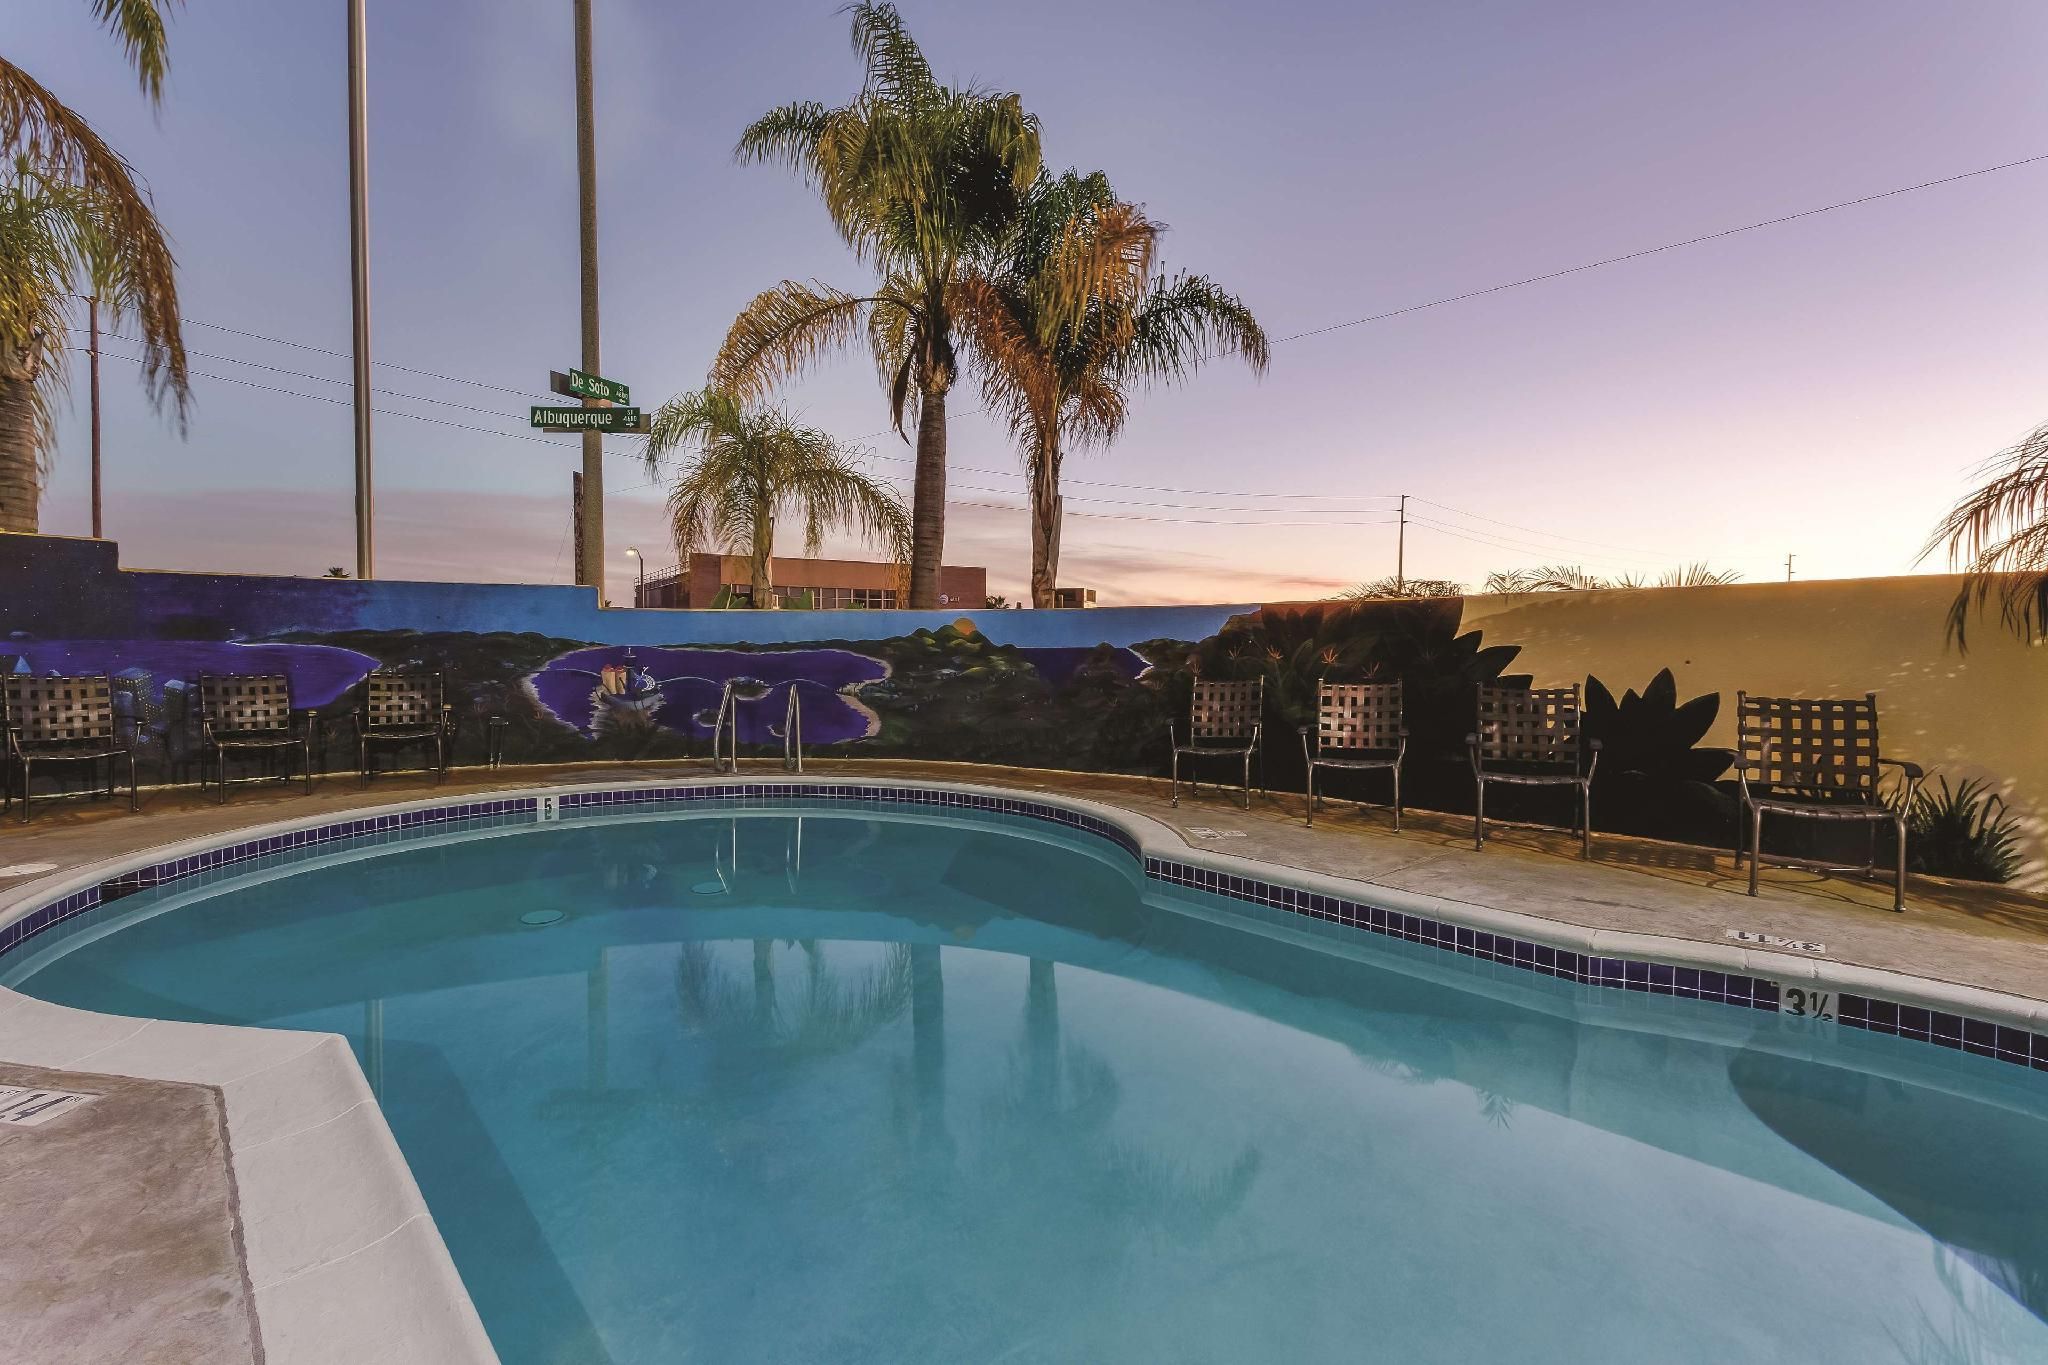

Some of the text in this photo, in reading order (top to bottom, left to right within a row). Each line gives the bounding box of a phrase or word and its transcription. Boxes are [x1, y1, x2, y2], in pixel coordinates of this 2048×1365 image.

[571, 372, 610, 397] De Soto
[533, 409, 613, 428] Albuquerque
